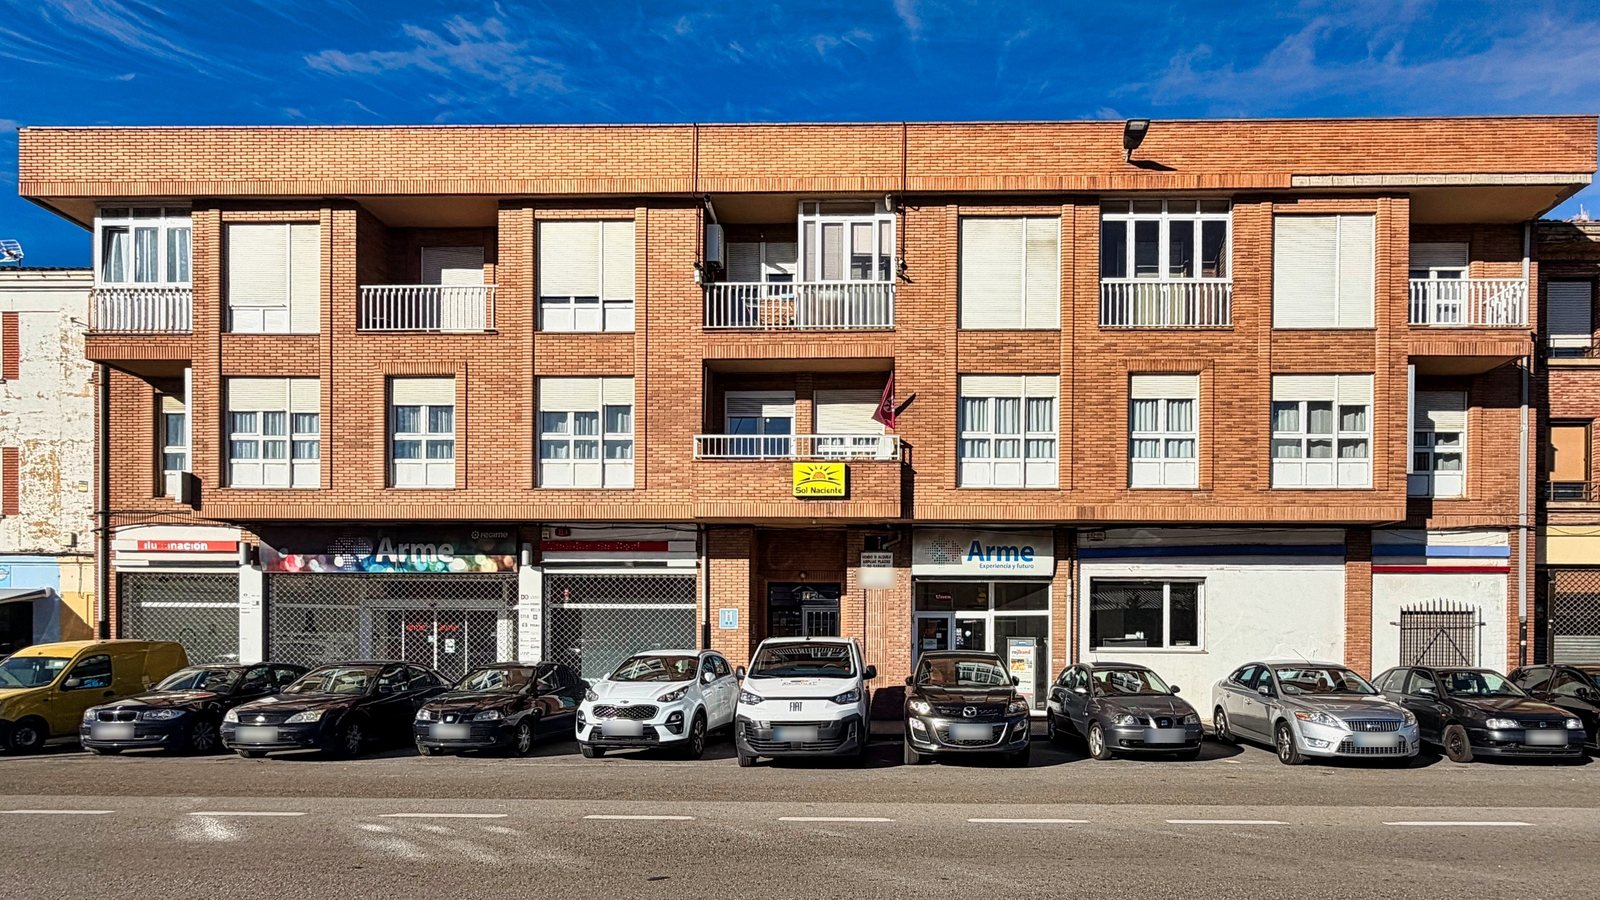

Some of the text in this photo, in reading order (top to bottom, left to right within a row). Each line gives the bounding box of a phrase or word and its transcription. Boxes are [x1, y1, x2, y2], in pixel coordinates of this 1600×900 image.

[375, 536, 455, 563] Arme
[967, 540, 1035, 562] Arme
[789, 702, 803, 712] FIAT
